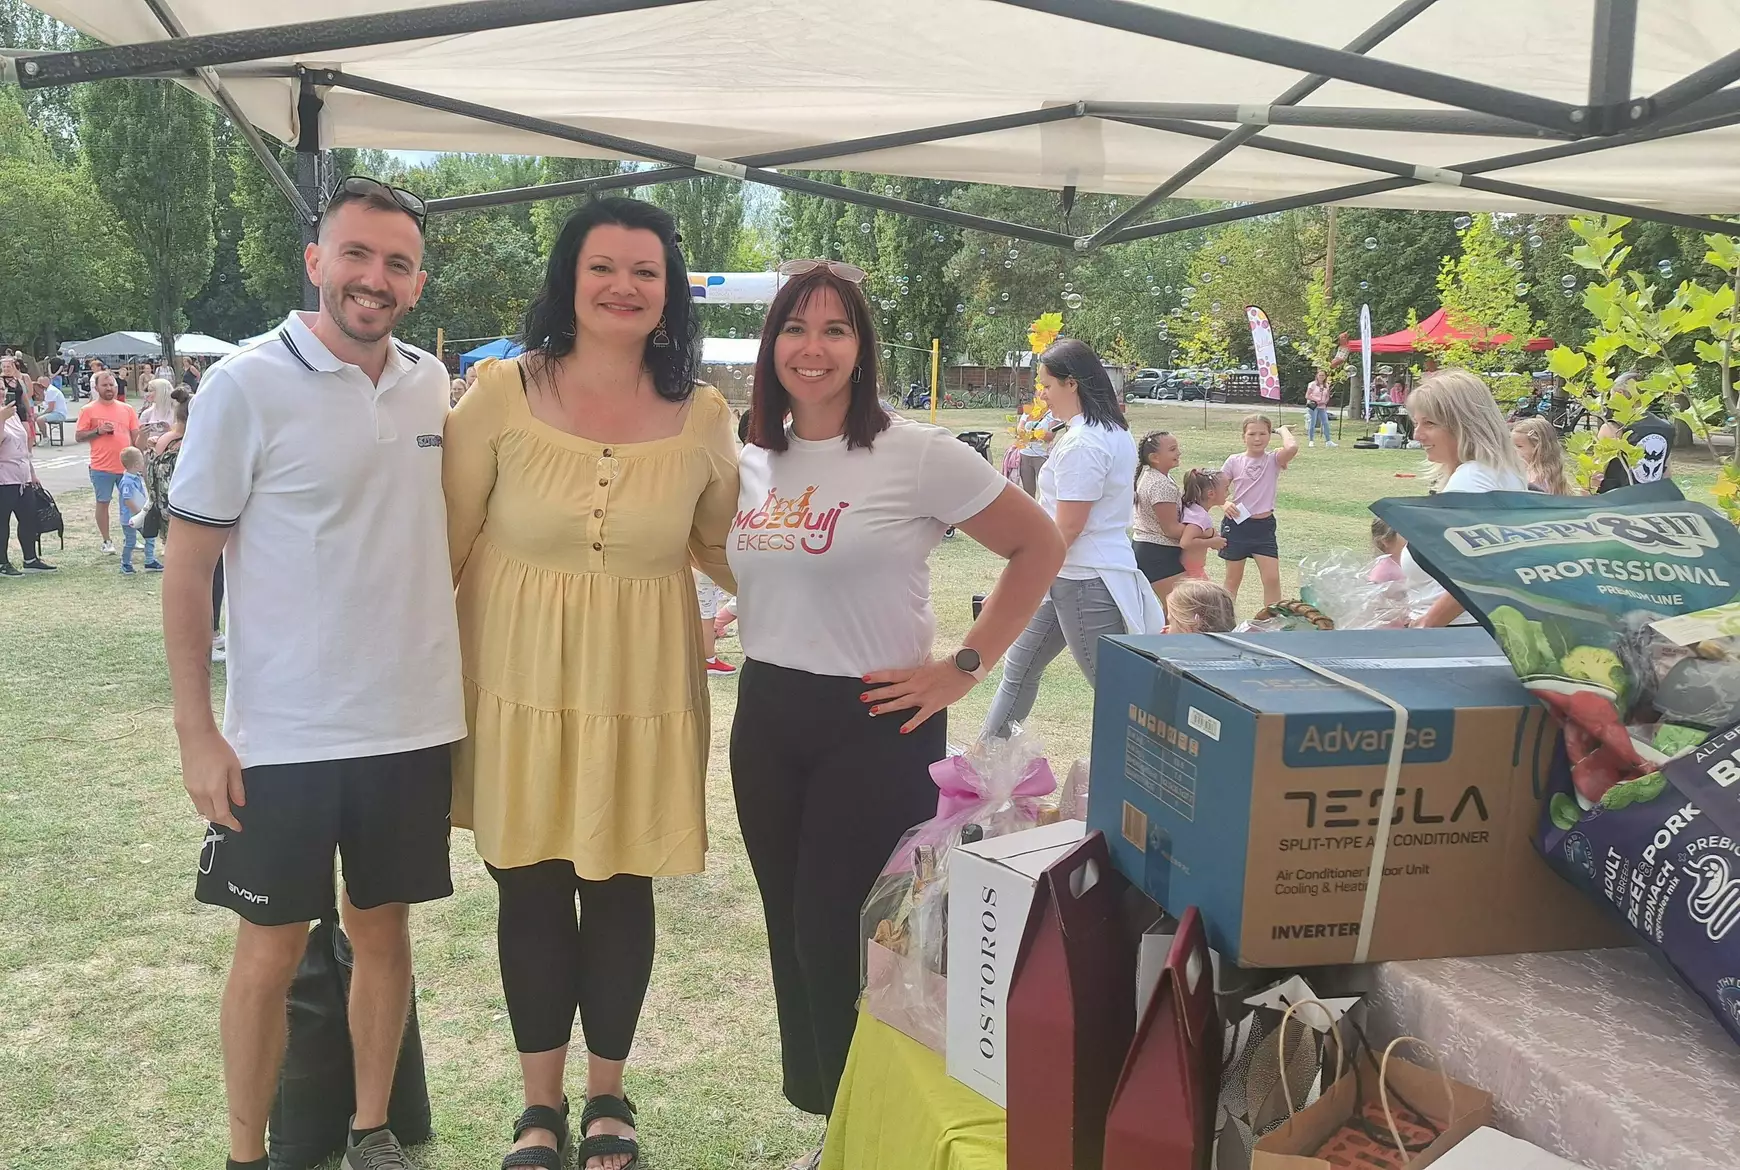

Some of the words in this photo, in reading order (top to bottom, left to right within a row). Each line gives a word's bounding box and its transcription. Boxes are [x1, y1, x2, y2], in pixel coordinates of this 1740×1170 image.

[737, 533, 796, 551] EKECS
[1456, 519, 1602, 549] HAPPY
[1640, 514, 1706, 538] FIT
[1597, 584, 1651, 602] PREMIUM
[1650, 593, 1684, 606] LINE
[1696, 742, 1726, 764] ALL
[1284, 785, 1489, 829] TESLA
[1279, 836, 1362, 852] SPLIT-TYPE
[1393, 831, 1489, 847] CONDITIONER
[1276, 869, 1294, 881] Air
[1295, 865, 1365, 881] Conditioner
[1367, 867, 1404, 877] Ioor
[1405, 864, 1430, 876] Unit
[1604, 846, 1622, 902] ADULT
[1627, 868, 1648, 929] BEEF
[1642, 801, 1702, 866] PORK
[227, 880, 269, 905] GIVOVA
[1274, 883, 1319, 897] Cooling
[1321, 882, 1331, 893] &
[1334, 880, 1368, 893] Heati
[1666, 876, 1681, 896] mix
[1644, 859, 1676, 936] SPINACH
[1271, 922, 1361, 940] INVERTER
[978, 885, 998, 1060] OSTOROS
